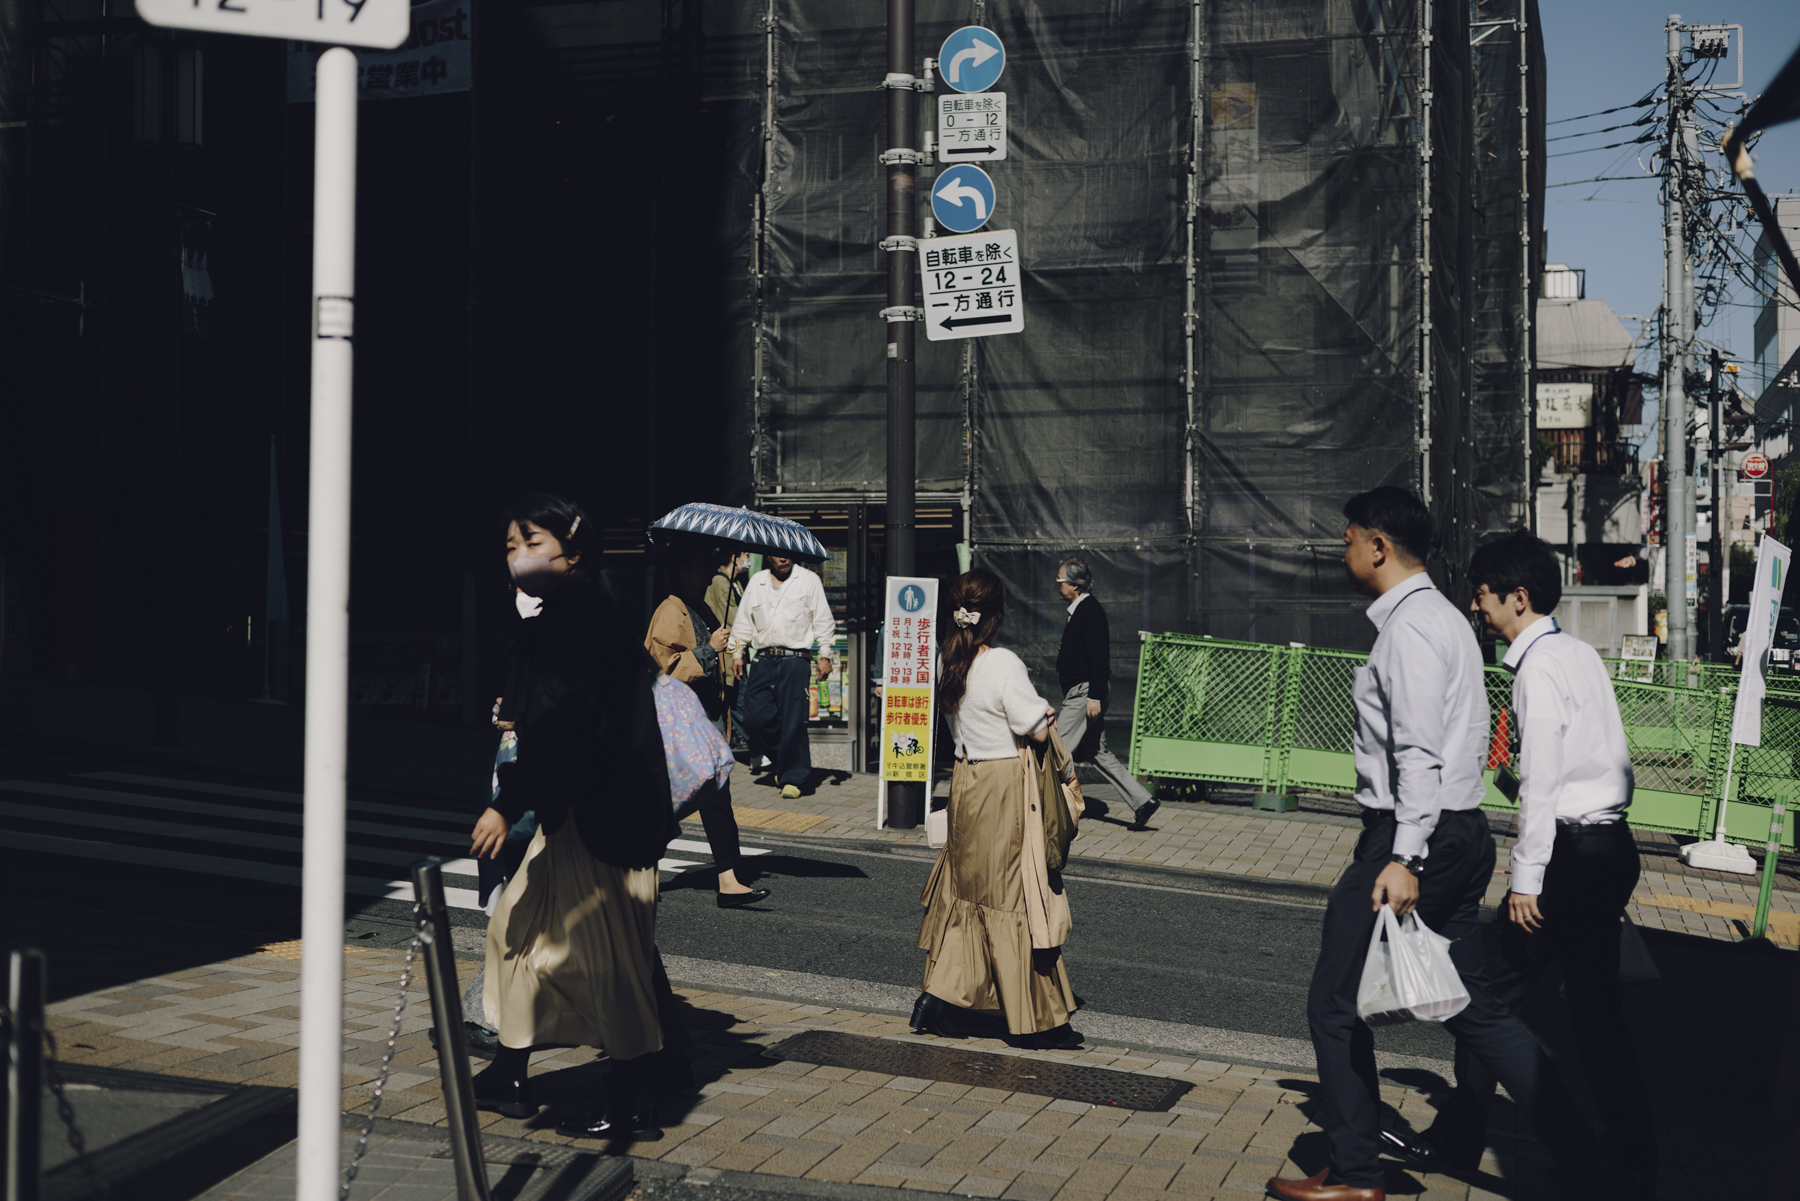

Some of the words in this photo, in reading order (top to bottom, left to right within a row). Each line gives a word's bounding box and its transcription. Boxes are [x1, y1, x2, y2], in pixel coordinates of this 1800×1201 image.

[942, 97, 1002, 112] 自転車を除く
[943, 128, 1002, 142] 一方通行
[926, 242, 1012, 267] 自転車を除く
[932, 290, 1015, 312] 一方通行
[916, 617, 931, 684] 歩行者天国
[887, 695, 929, 709] 自転車は徐行
[886, 711, 928, 726] 歩行者優先
[892, 762, 926, 771] 牛込警察署
